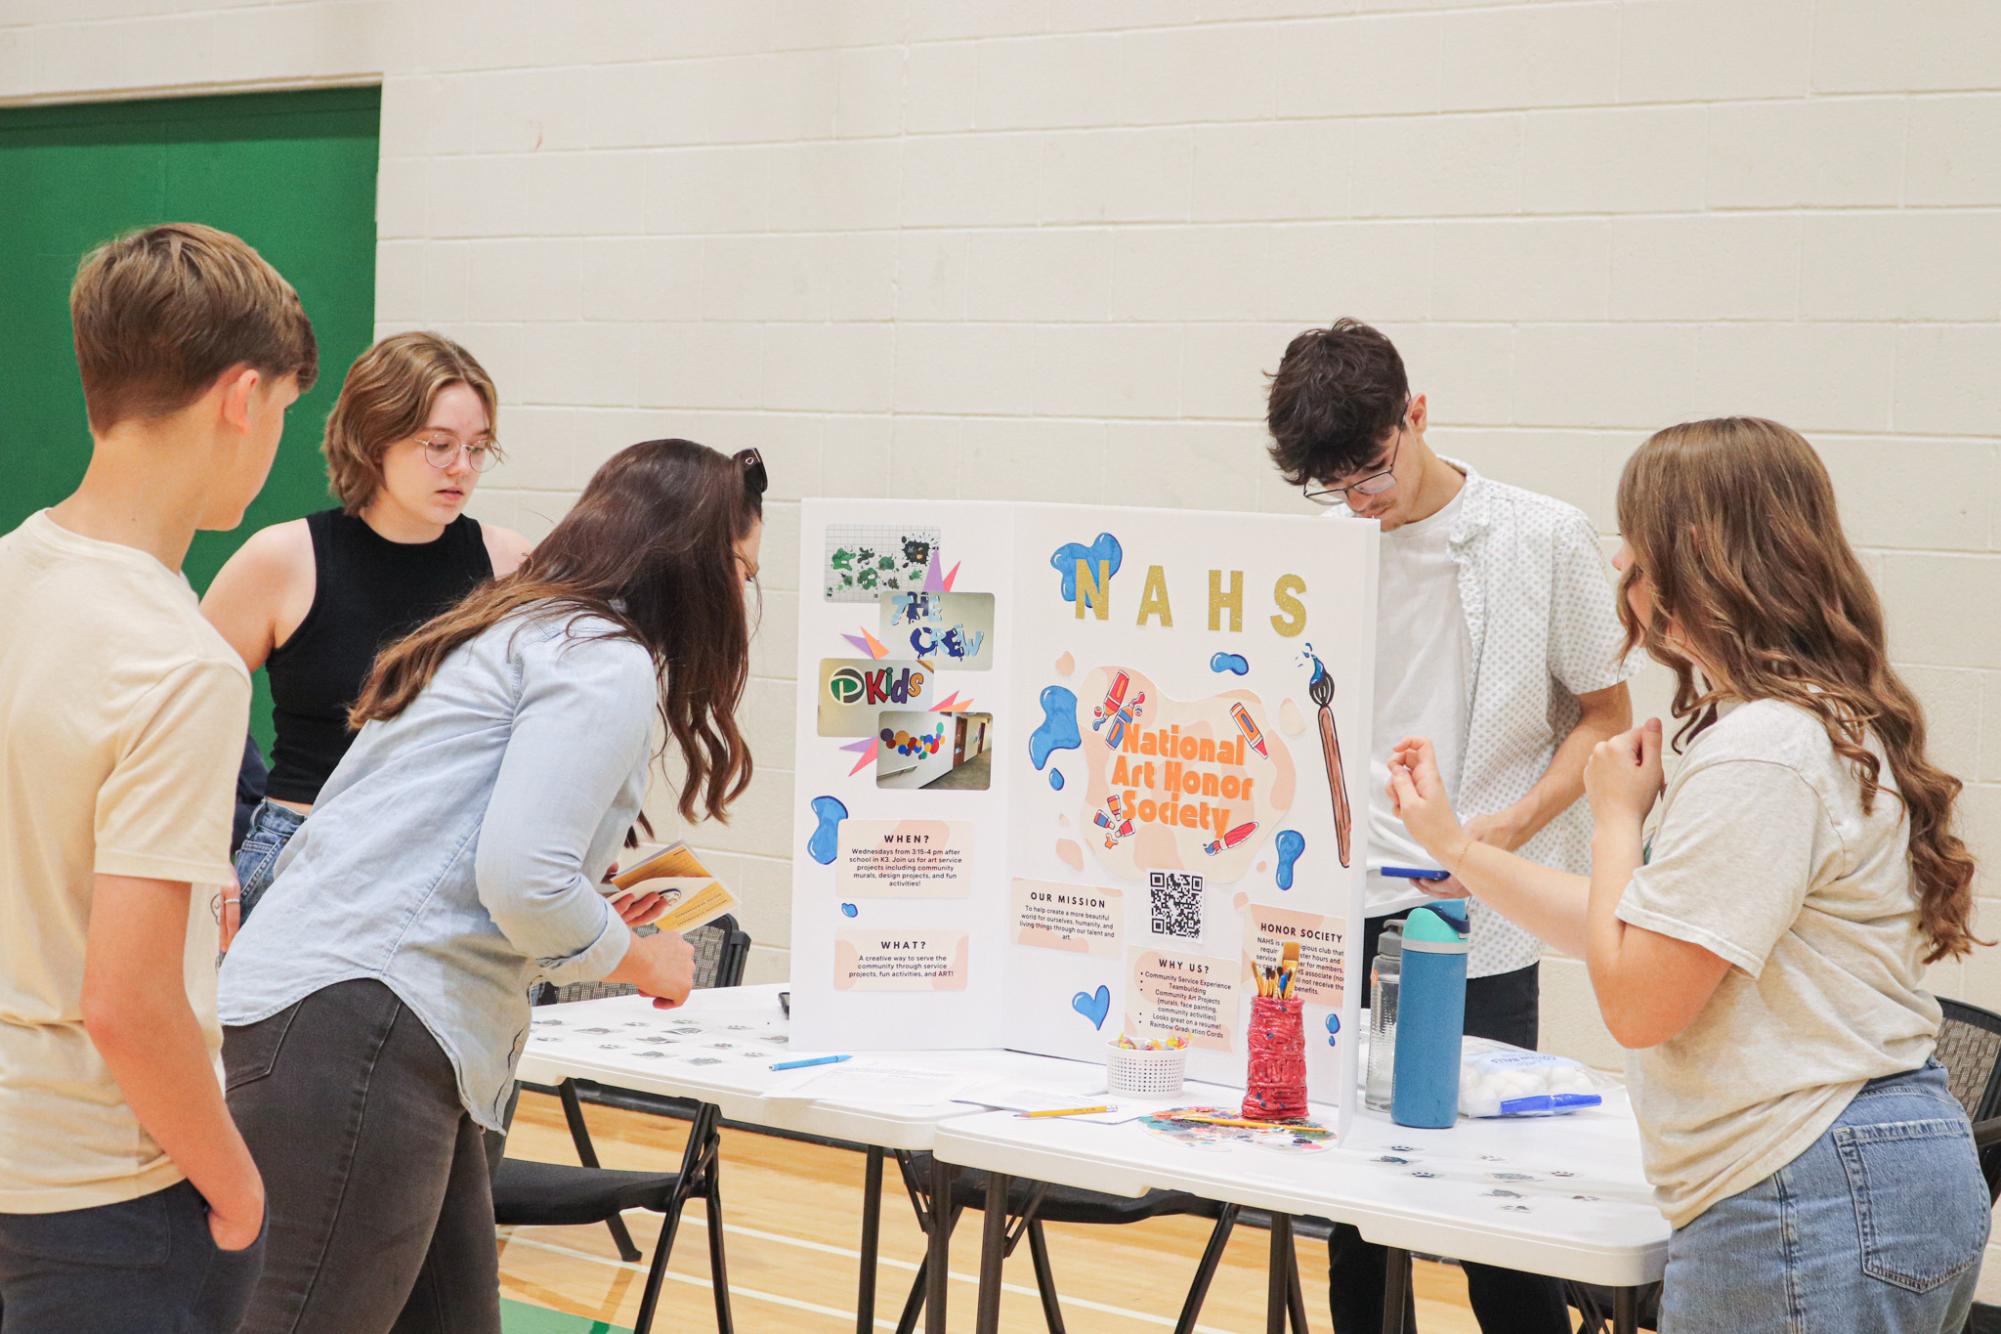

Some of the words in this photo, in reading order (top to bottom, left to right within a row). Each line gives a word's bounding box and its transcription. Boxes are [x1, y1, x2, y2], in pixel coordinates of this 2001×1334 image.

[890, 592, 943, 625] THE
[910, 624, 984, 661] CREW
[1122, 722, 1246, 766] National
[1111, 755, 1155, 789] Art
[1164, 760, 1254, 800] Honor
[1122, 790, 1231, 840] Society
[884, 835, 930, 843] WHEN?
[1031, 892, 1052, 902] OUR
[1058, 895, 1105, 908] MISSION
[1047, 917, 1073, 925] ourselves,
[1075, 920, 1101, 928] humanity,
[1085, 912, 1109, 920] beautiful
[1036, 922, 1052, 930] things
[1054, 924, 1075, 933] through
[1260, 923, 1296, 936] HONOR
[1300, 929, 1342, 943] SOCIETY
[881, 941, 926, 949] WHAT?
[1257, 937, 1274, 945] NAHS
[1256, 955, 1276, 963] service
[1316, 965, 1343, 973] members.
[1312, 955, 1328, 963] hours
[1159, 959, 1183, 970] WHY
[1189, 963, 1209, 974] US?
[1145, 971, 1176, 982] Community
[1178, 976, 1199, 985] Service
[1200, 980, 1231, 990] Experience
[1305, 970, 1334, 979] associate
[1169, 983, 1206, 995] Teambuilding
[1313, 980, 1333, 989] receive
[1155, 989, 1187, 1000] Community
[1198, 996, 1220, 1005] Projects
[1158, 1007, 1188, 1017] community
[1150, 1021, 1173, 1030] Rainbow
[1153, 1013, 1169, 1021] Looks
[1170, 1016, 1184, 1024] great
[1199, 1021, 1221, 1029] resume!
